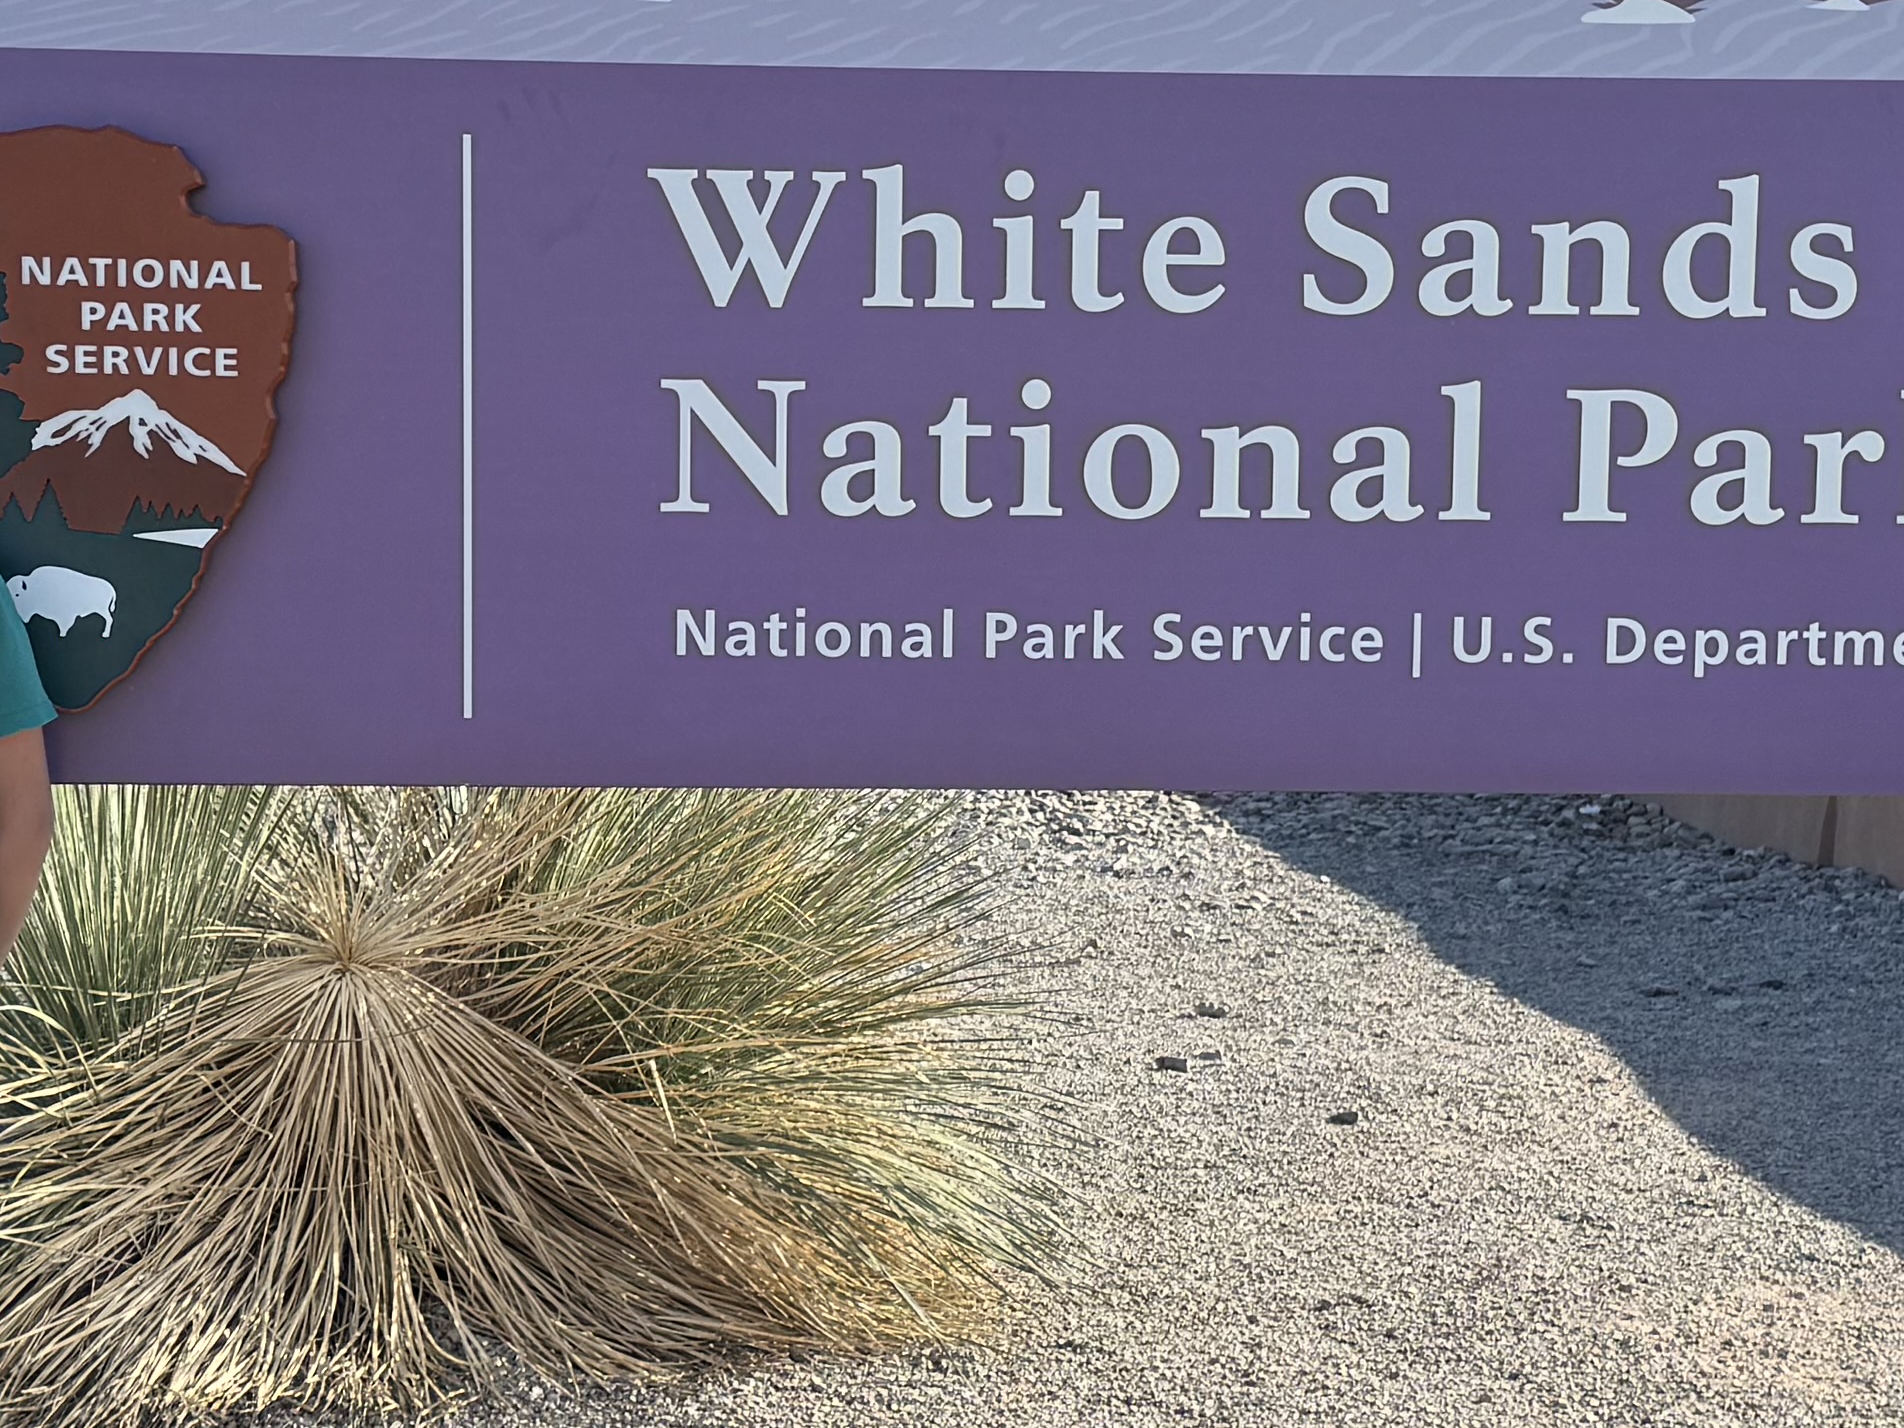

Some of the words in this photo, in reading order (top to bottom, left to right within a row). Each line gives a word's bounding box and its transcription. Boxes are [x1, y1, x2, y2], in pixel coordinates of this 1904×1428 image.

[647, 162, 1227, 315] White
[1302, 172, 1859, 321] Sands
[20, 254, 264, 292] NATIONAL
[79, 300, 204, 334] PARK
[44, 342, 240, 378] SERVICE
[659, 377, 1492, 524] National
[674, 606, 955, 661] National
[983, 608, 1126, 662] Park
[1151, 611, 1385, 665] Service
[1451, 615, 1575, 666] U.S.
